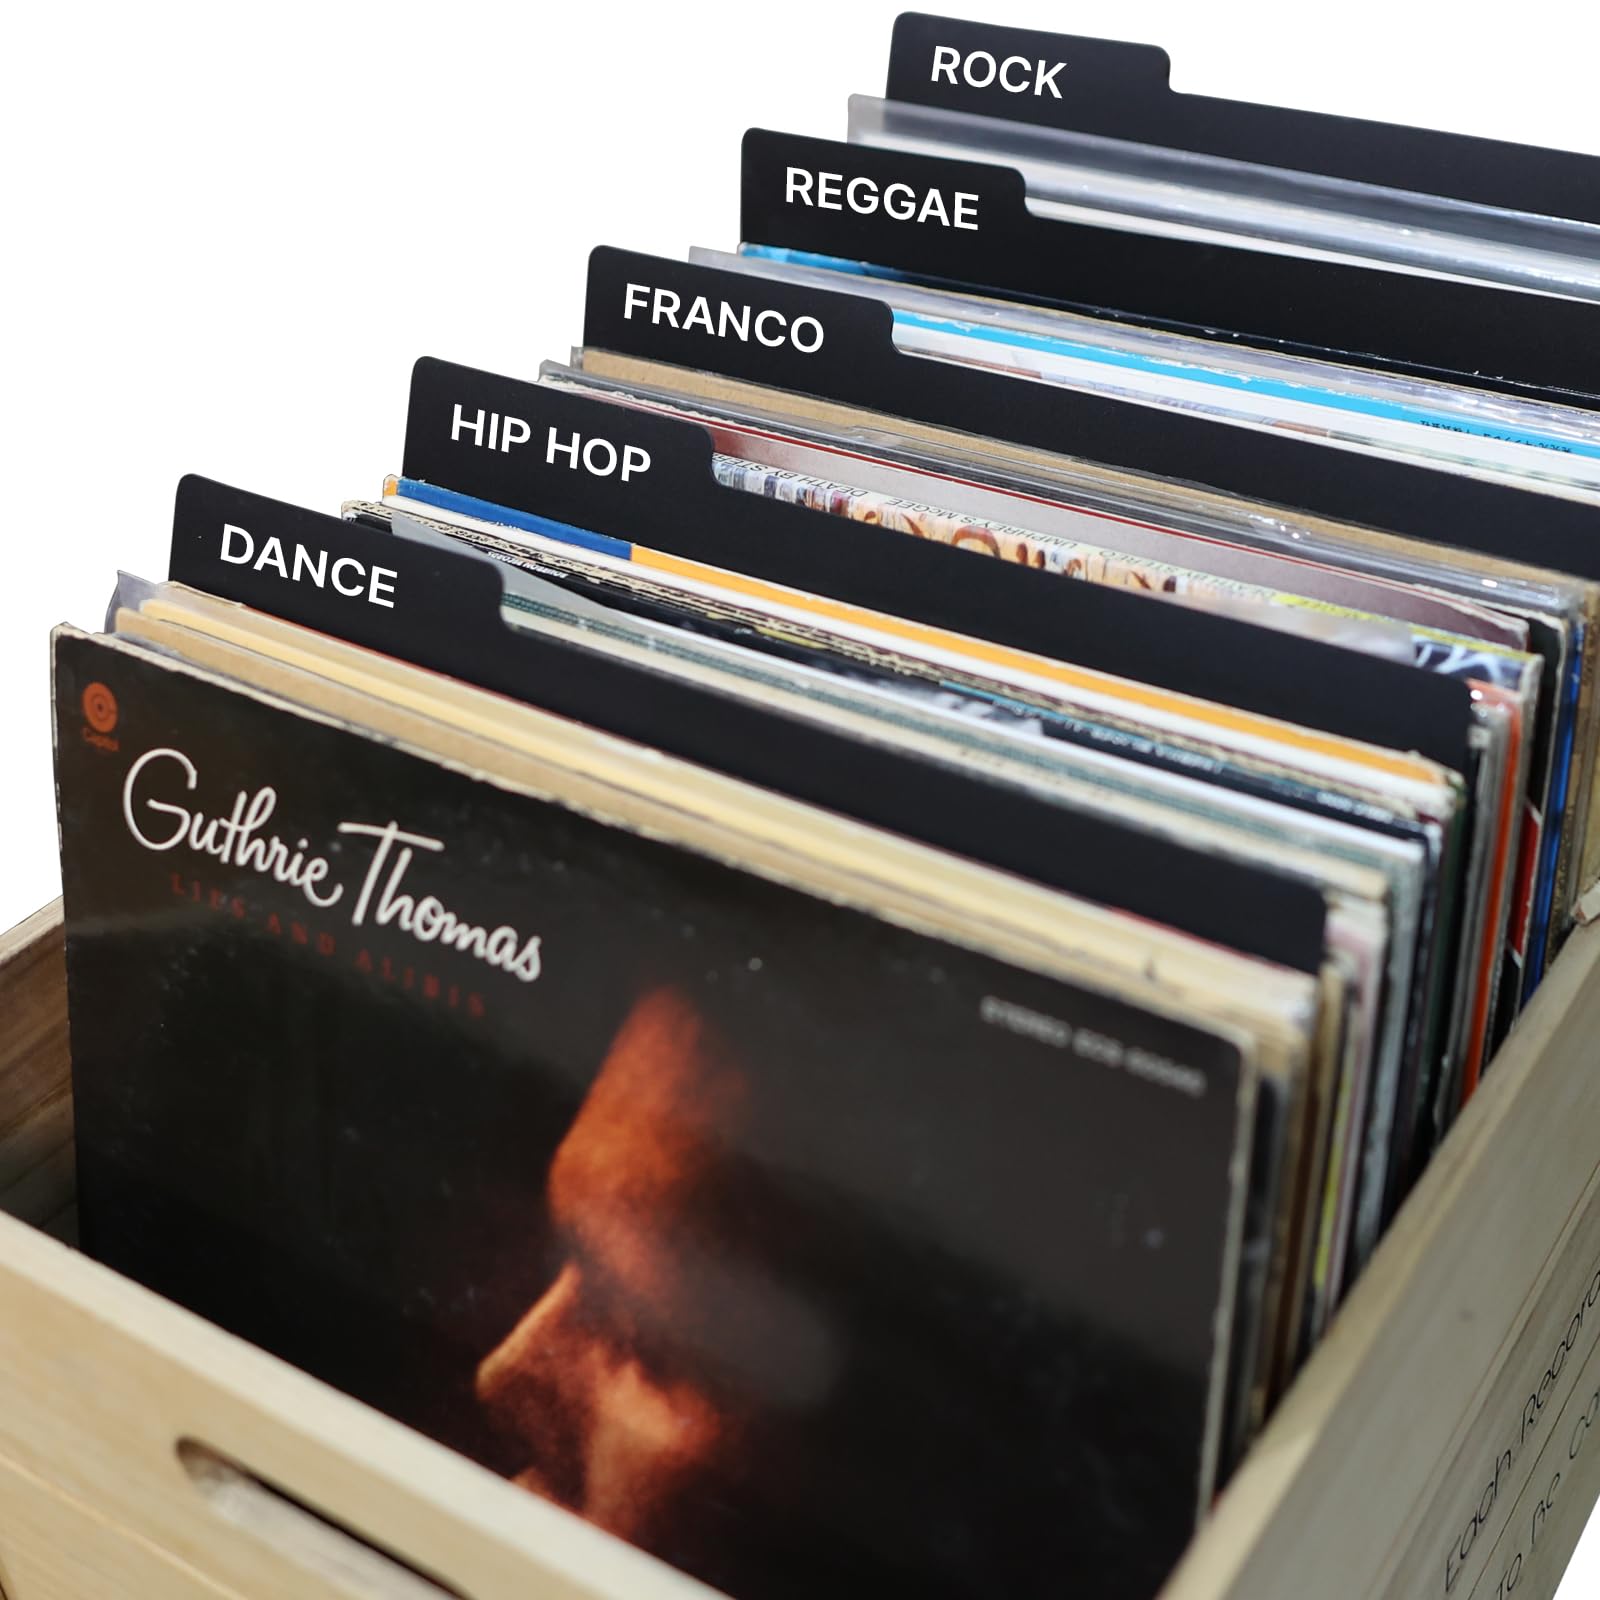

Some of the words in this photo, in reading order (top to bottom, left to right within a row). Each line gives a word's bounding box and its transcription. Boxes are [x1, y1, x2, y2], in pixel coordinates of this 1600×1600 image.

[931, 46, 1067, 98] ROCK
[786, 167, 979, 230] REGGAE
[624, 283, 824, 353] FRANCO
[451, 404, 531, 452] HIP
[546, 427, 651, 481] HOP
[766, 469, 798, 481] BY
[797, 476, 868, 497] DEATH
[886, 498, 957, 519] McGEE
[960, 516, 1078, 549] UMPHREY'S
[221, 524, 398, 608] DANCE
[124, 748, 344, 907] Guthrie
[339, 822, 541, 982] Thomas
[267, 913, 335, 955] AND
[1445, 1449, 1511, 1593] Each
